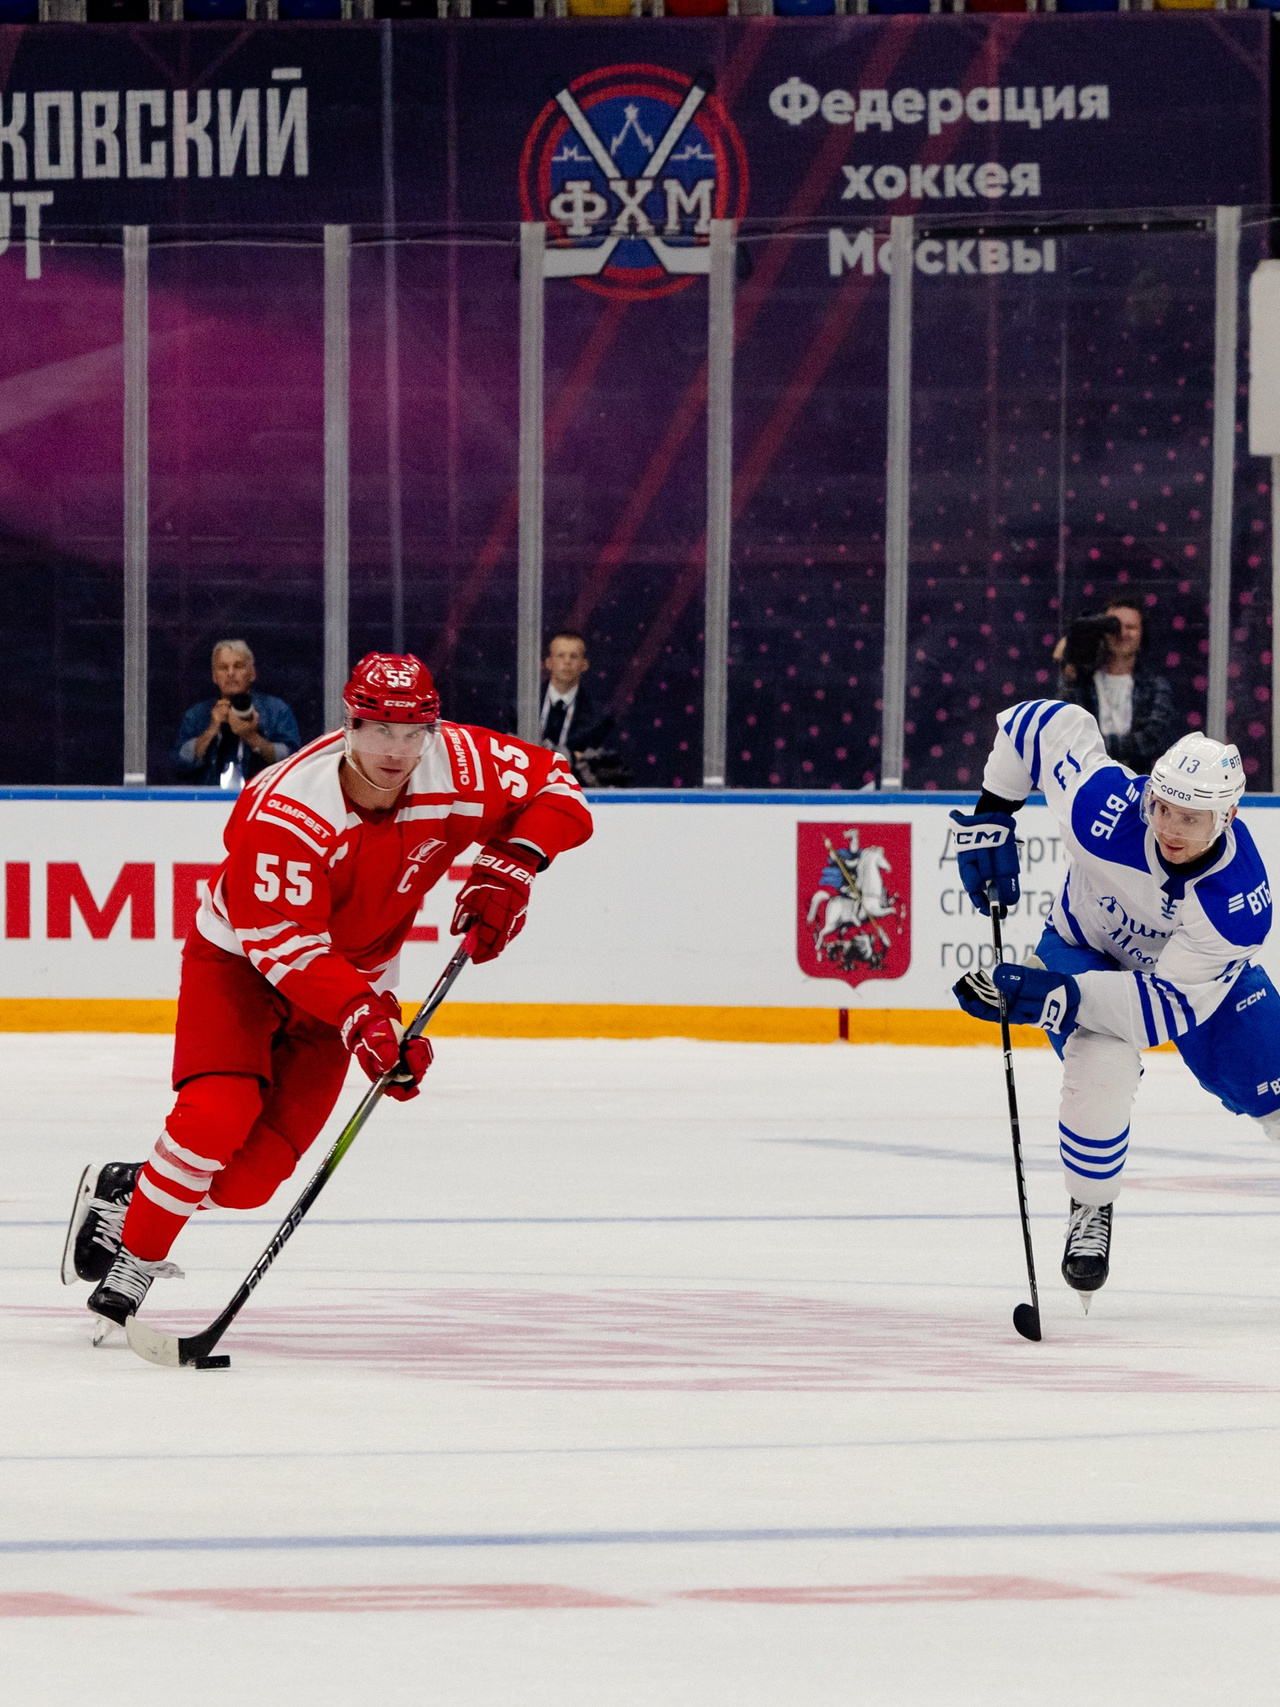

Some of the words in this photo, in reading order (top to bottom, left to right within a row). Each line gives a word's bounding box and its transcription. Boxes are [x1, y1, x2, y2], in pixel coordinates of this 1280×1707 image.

[769, 77, 1110, 135] Федерация
[841, 162, 1042, 200] хоккея
[550, 178, 715, 236] ФХМ
[0, 190, 54, 279] Т
[385, 670, 412, 687] 55
[383, 699, 417, 708] CCM
[1177, 755, 1201, 774] 13
[266, 799, 331, 840] OLIMPBET
[1090, 793, 1129, 841] ВТБ
[253, 852, 313, 906] 55
[1235, 988, 1267, 1013] CCM
